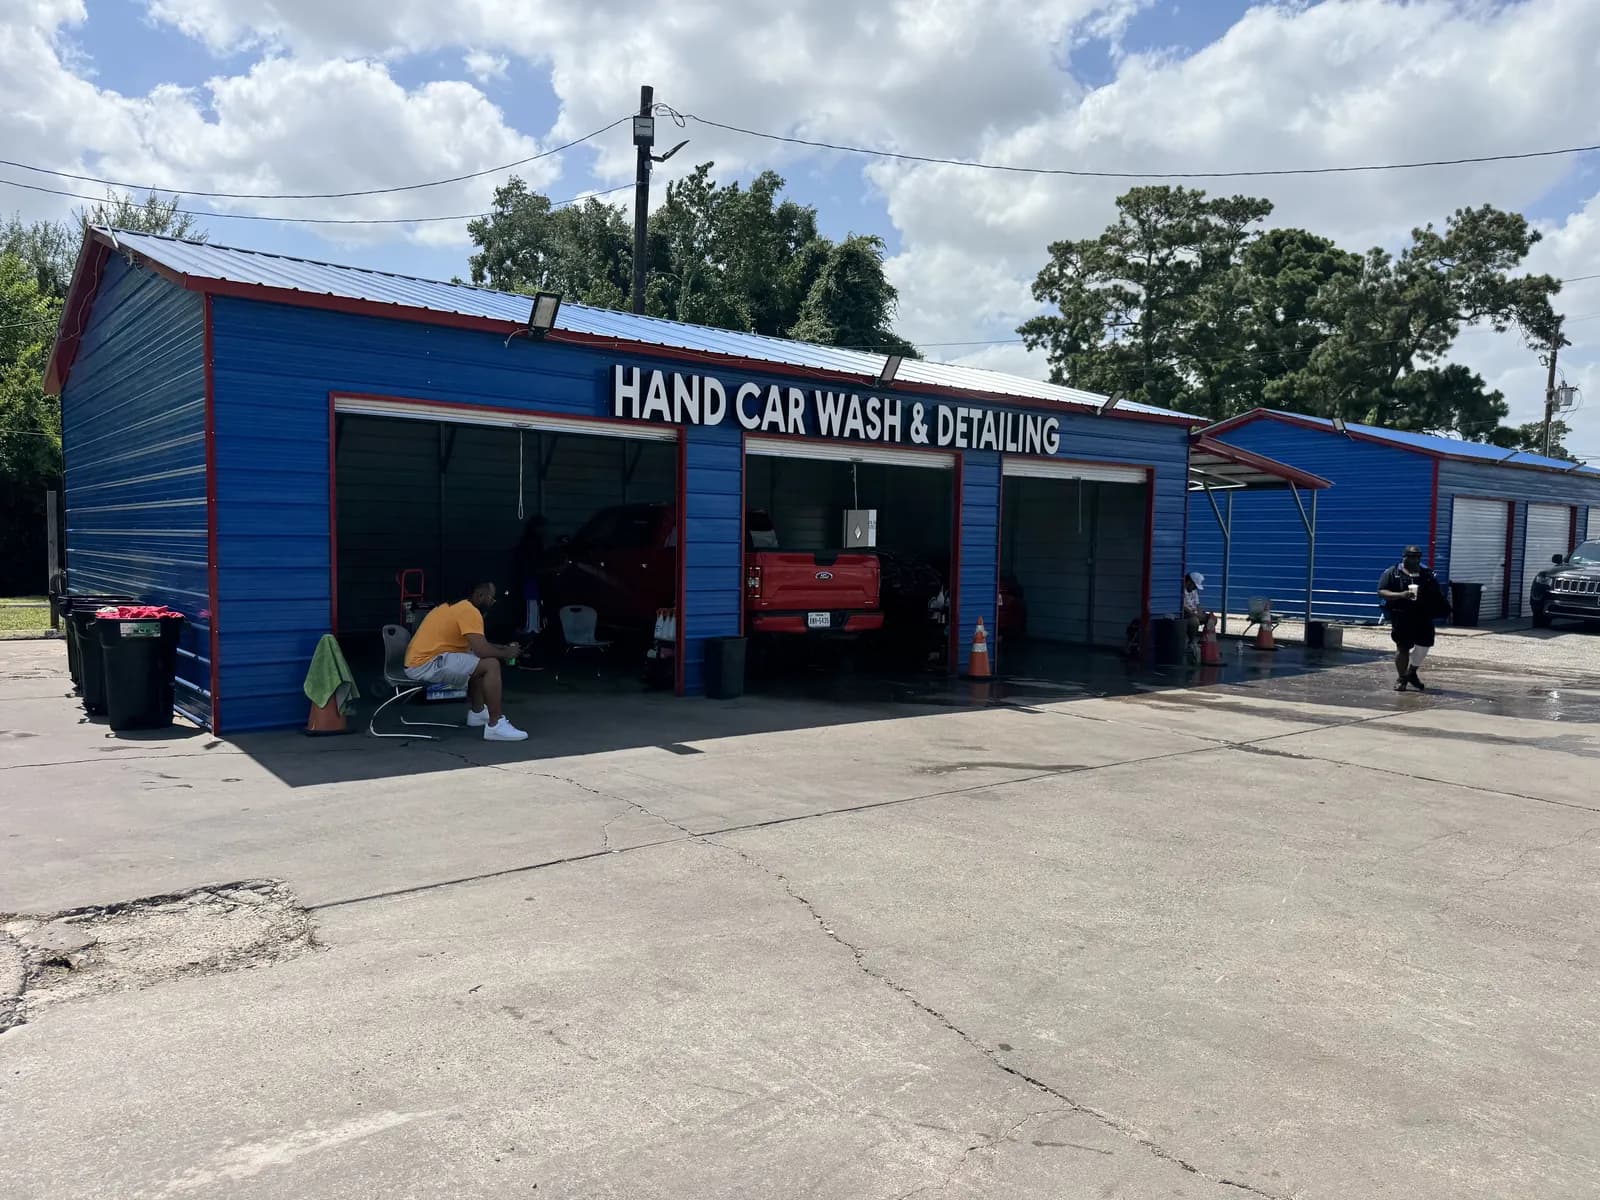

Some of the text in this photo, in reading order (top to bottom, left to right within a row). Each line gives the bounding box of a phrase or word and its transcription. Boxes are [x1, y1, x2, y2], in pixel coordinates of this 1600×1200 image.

[614, 364, 1060, 455] HAND CAR WASH & DETAILING
